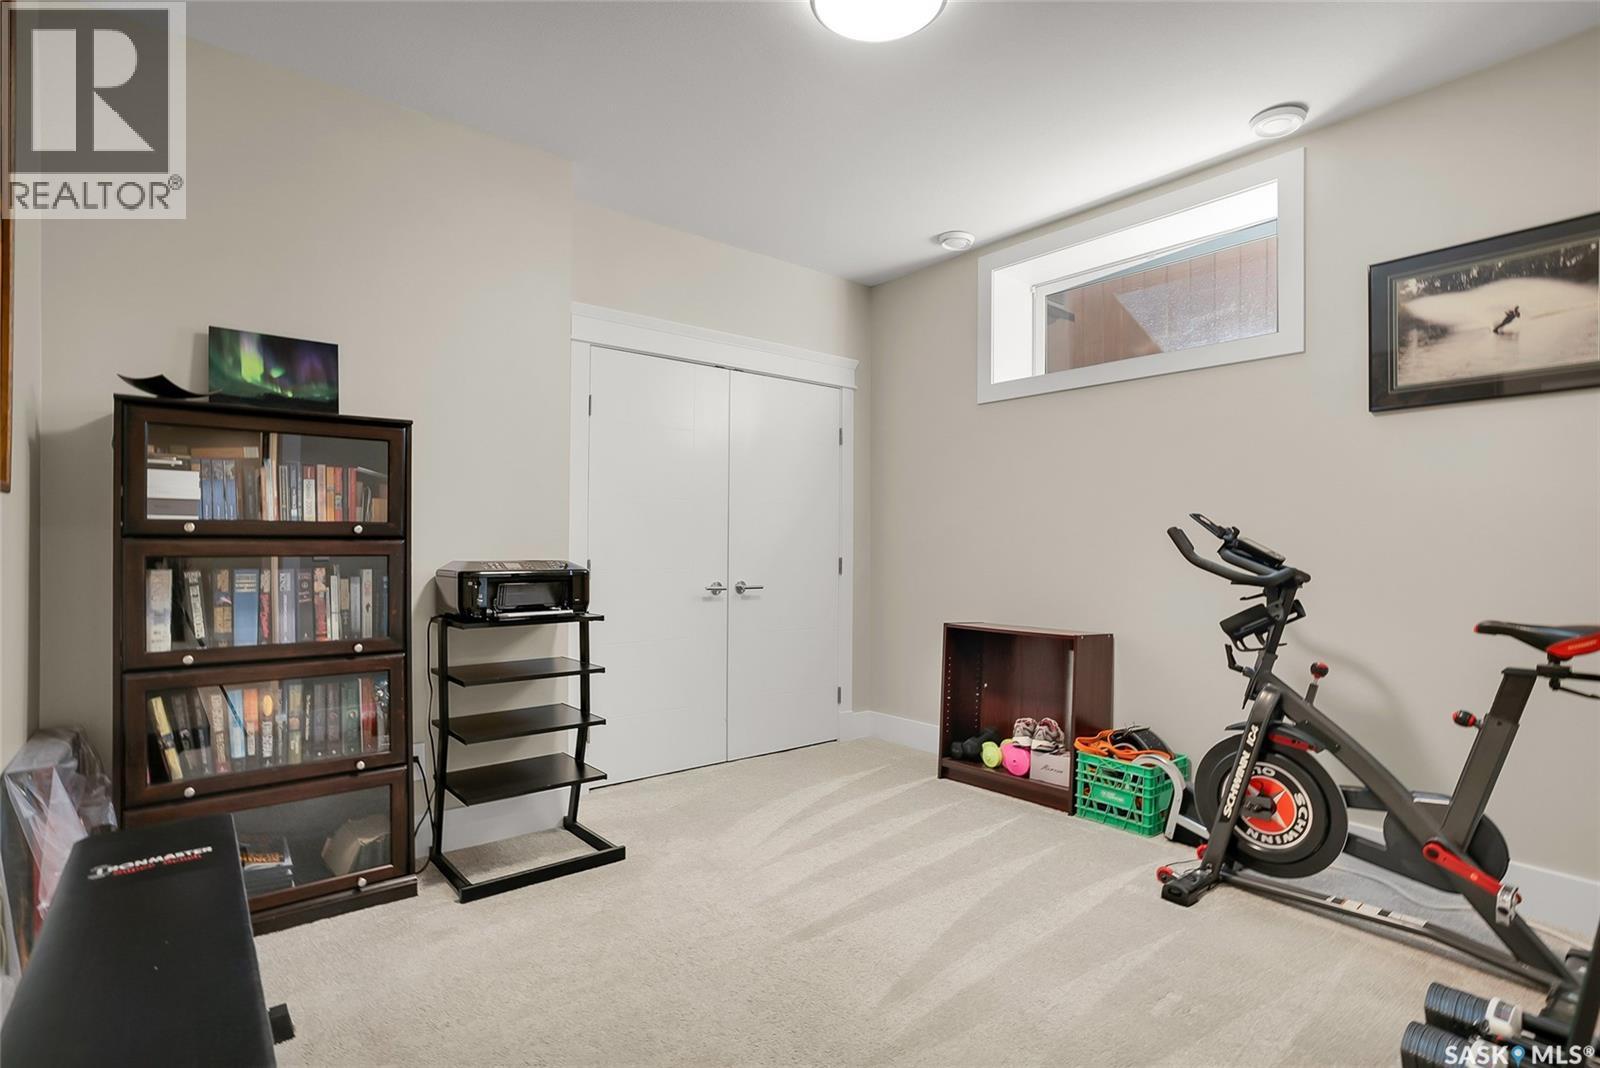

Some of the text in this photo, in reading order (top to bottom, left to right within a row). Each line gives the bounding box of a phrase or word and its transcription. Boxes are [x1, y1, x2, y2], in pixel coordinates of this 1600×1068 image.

[1223, 724, 1259, 819] SCHWINN IC4
[1246, 792, 1308, 844] SCHWINN
